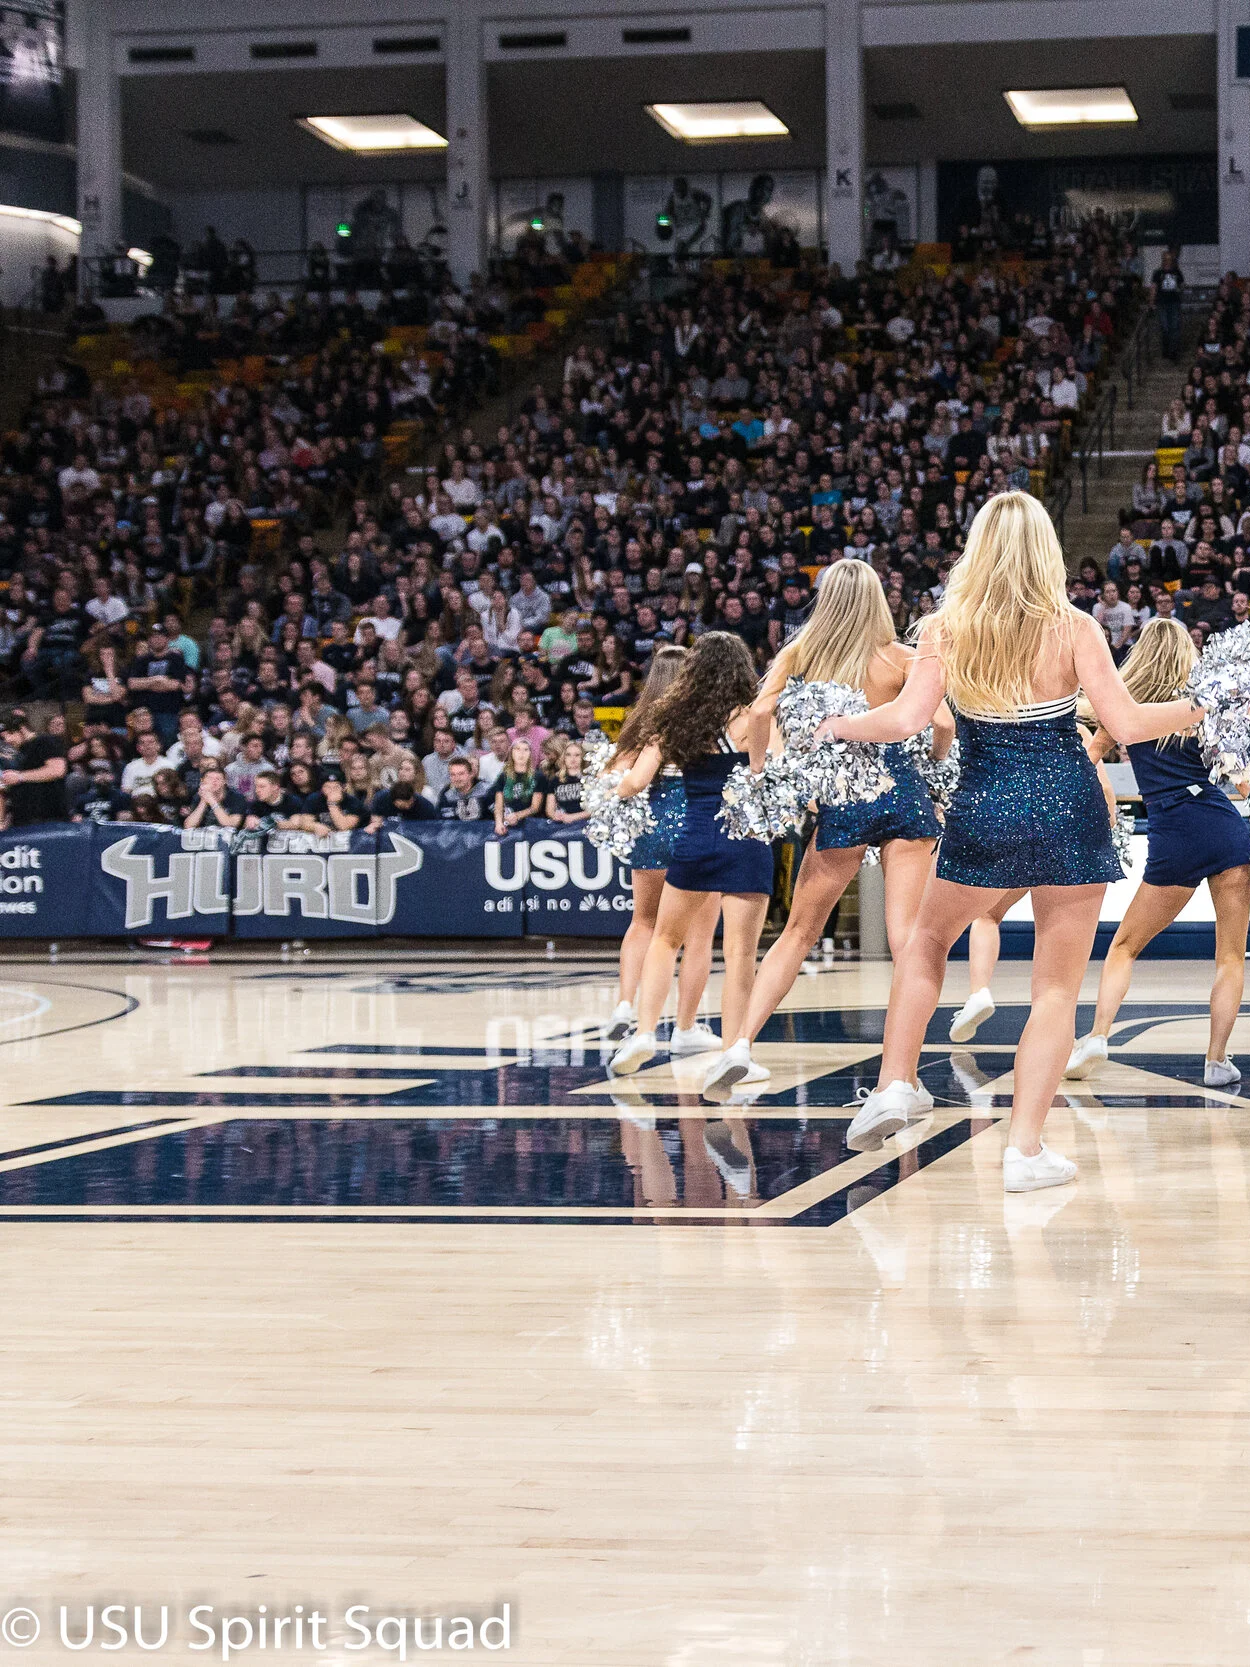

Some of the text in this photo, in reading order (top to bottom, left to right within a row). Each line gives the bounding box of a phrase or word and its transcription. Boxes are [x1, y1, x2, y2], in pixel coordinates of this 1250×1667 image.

[1229, 156, 1243, 174] L
[836, 168, 851, 186] K
[456, 181, 468, 199] J
[0, 845, 42, 869] dit
[484, 840, 613, 891] USU
[104, 836, 421, 929] HURD
